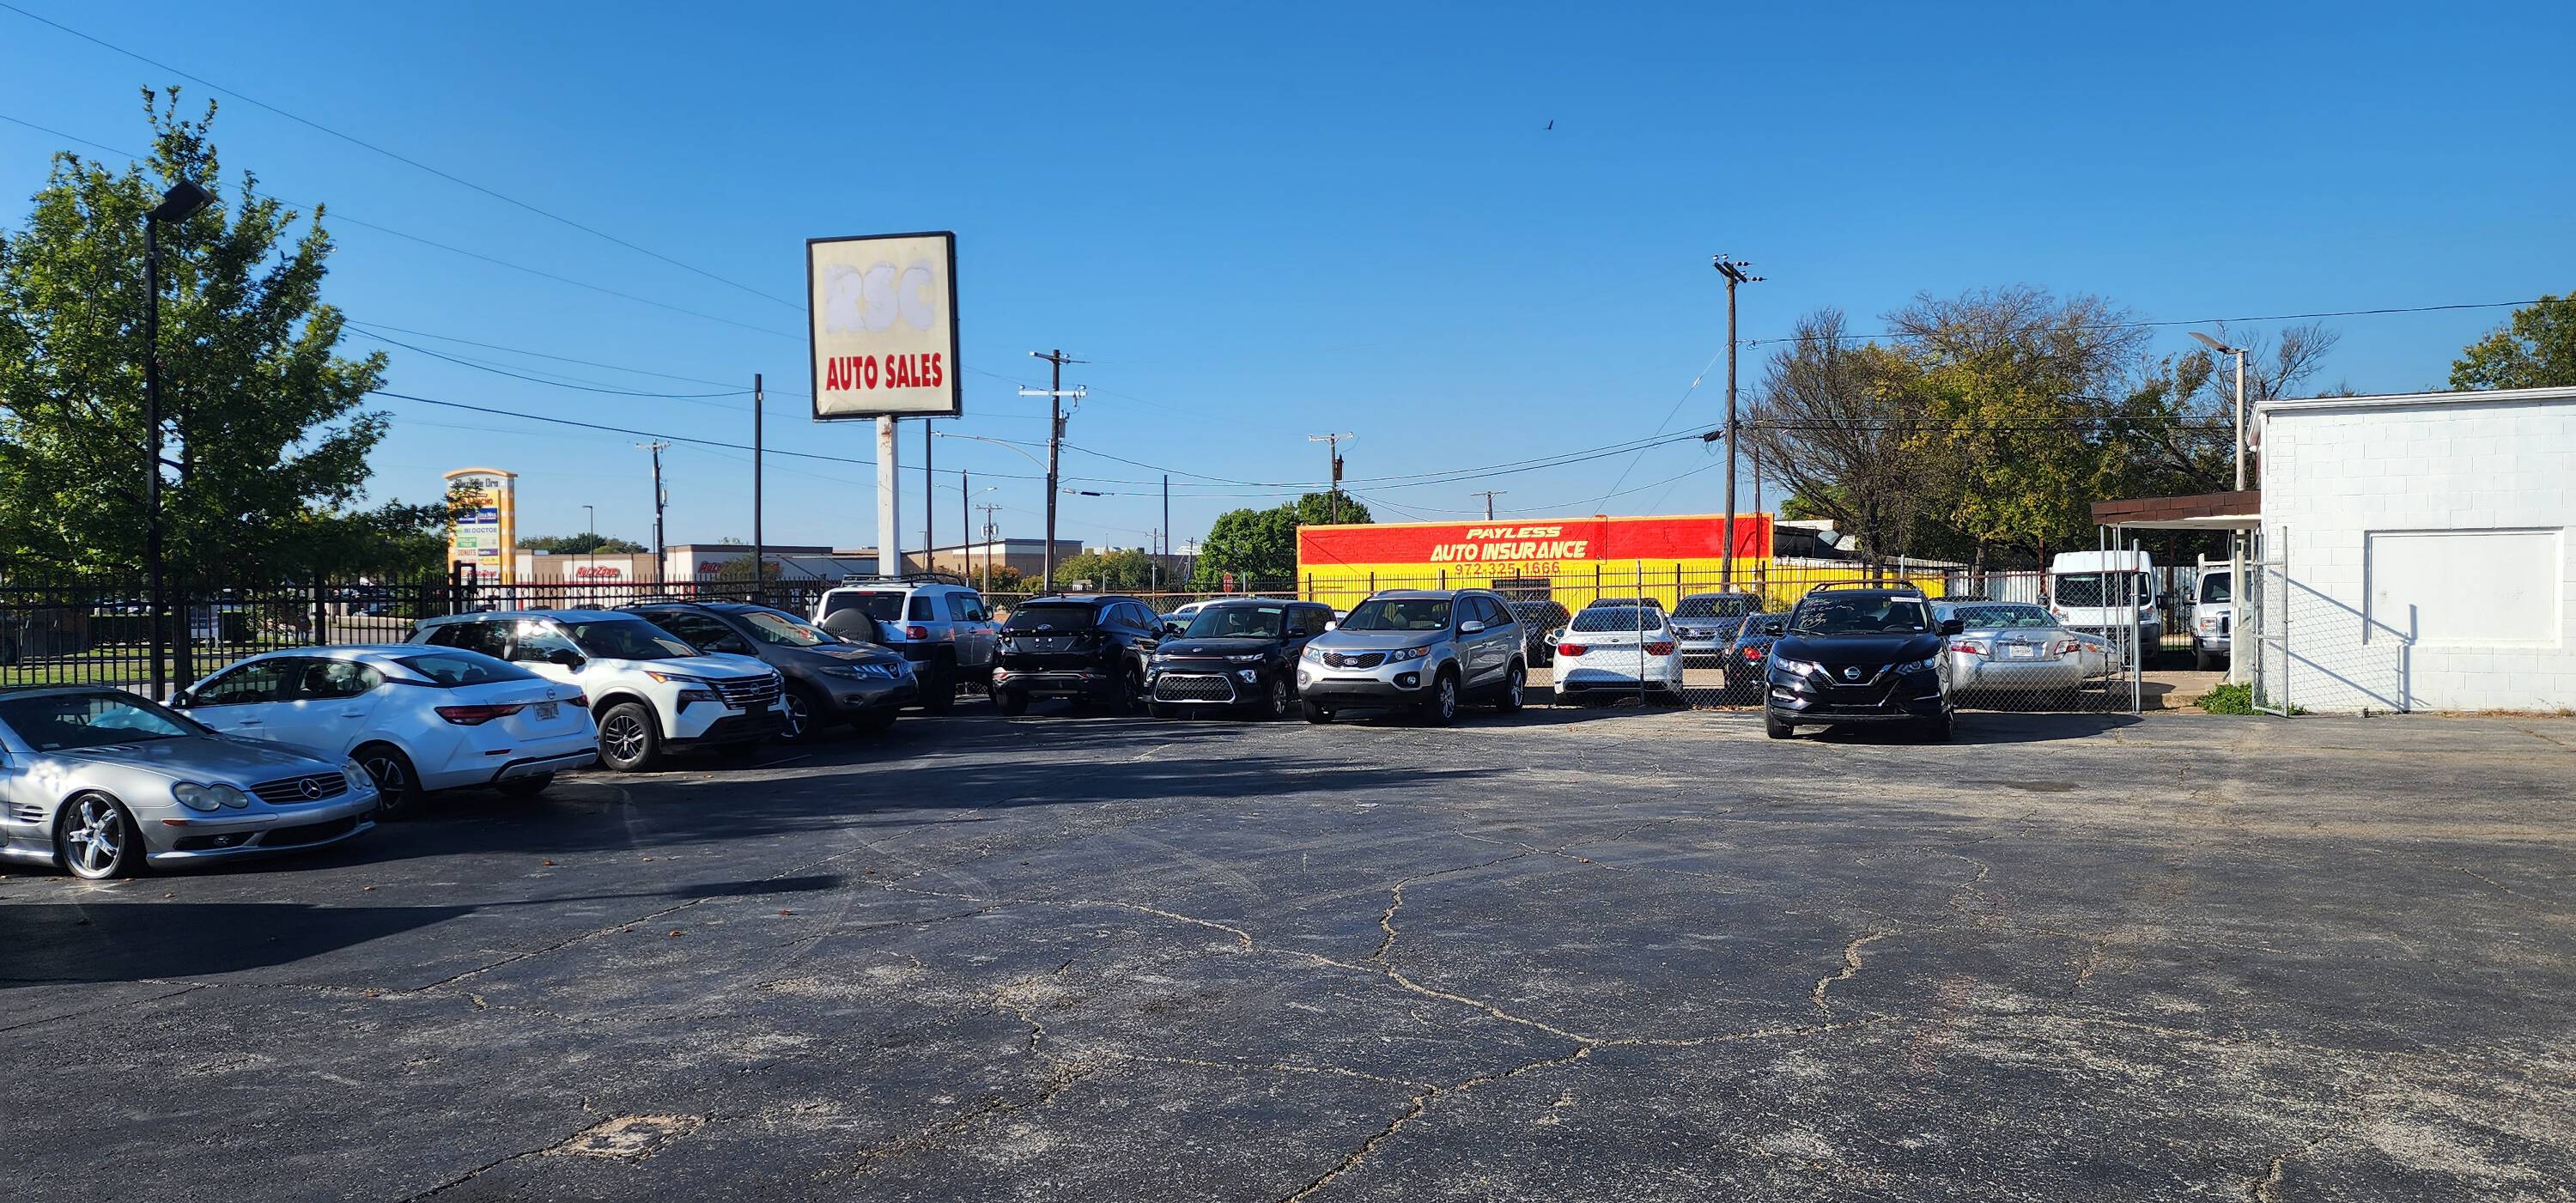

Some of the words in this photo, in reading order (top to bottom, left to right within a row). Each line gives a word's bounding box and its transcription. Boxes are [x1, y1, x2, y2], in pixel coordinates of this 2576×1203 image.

[826, 355, 878, 391] AUTO
[884, 352, 943, 389] SALES
[1466, 526, 1564, 540] PAYLESS
[1430, 544, 1479, 562] AUTO
[1481, 540, 1589, 561] INSURANCE
[577, 565, 618, 577] AutoZone
[1455, 561, 1561, 574] 972-3251666
